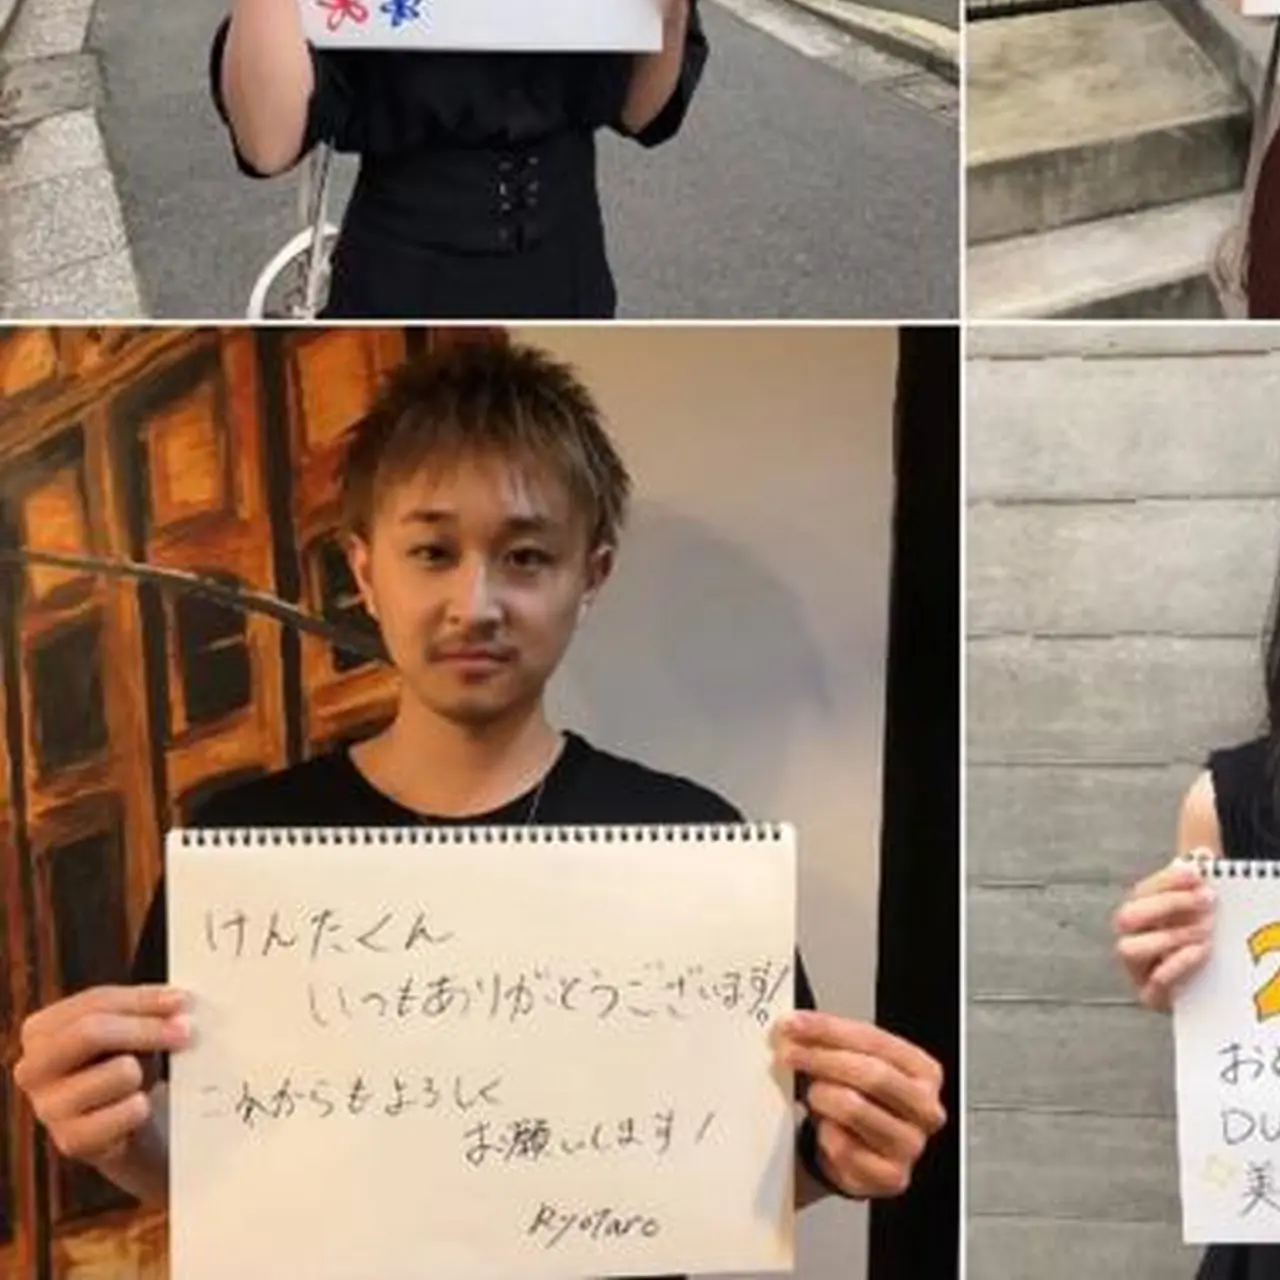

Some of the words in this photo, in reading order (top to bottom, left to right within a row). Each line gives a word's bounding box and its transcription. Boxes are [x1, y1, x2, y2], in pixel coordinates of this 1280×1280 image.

[203, 907, 457, 960] けんたくん
[200, 1074, 503, 1128] これからもよろしく
